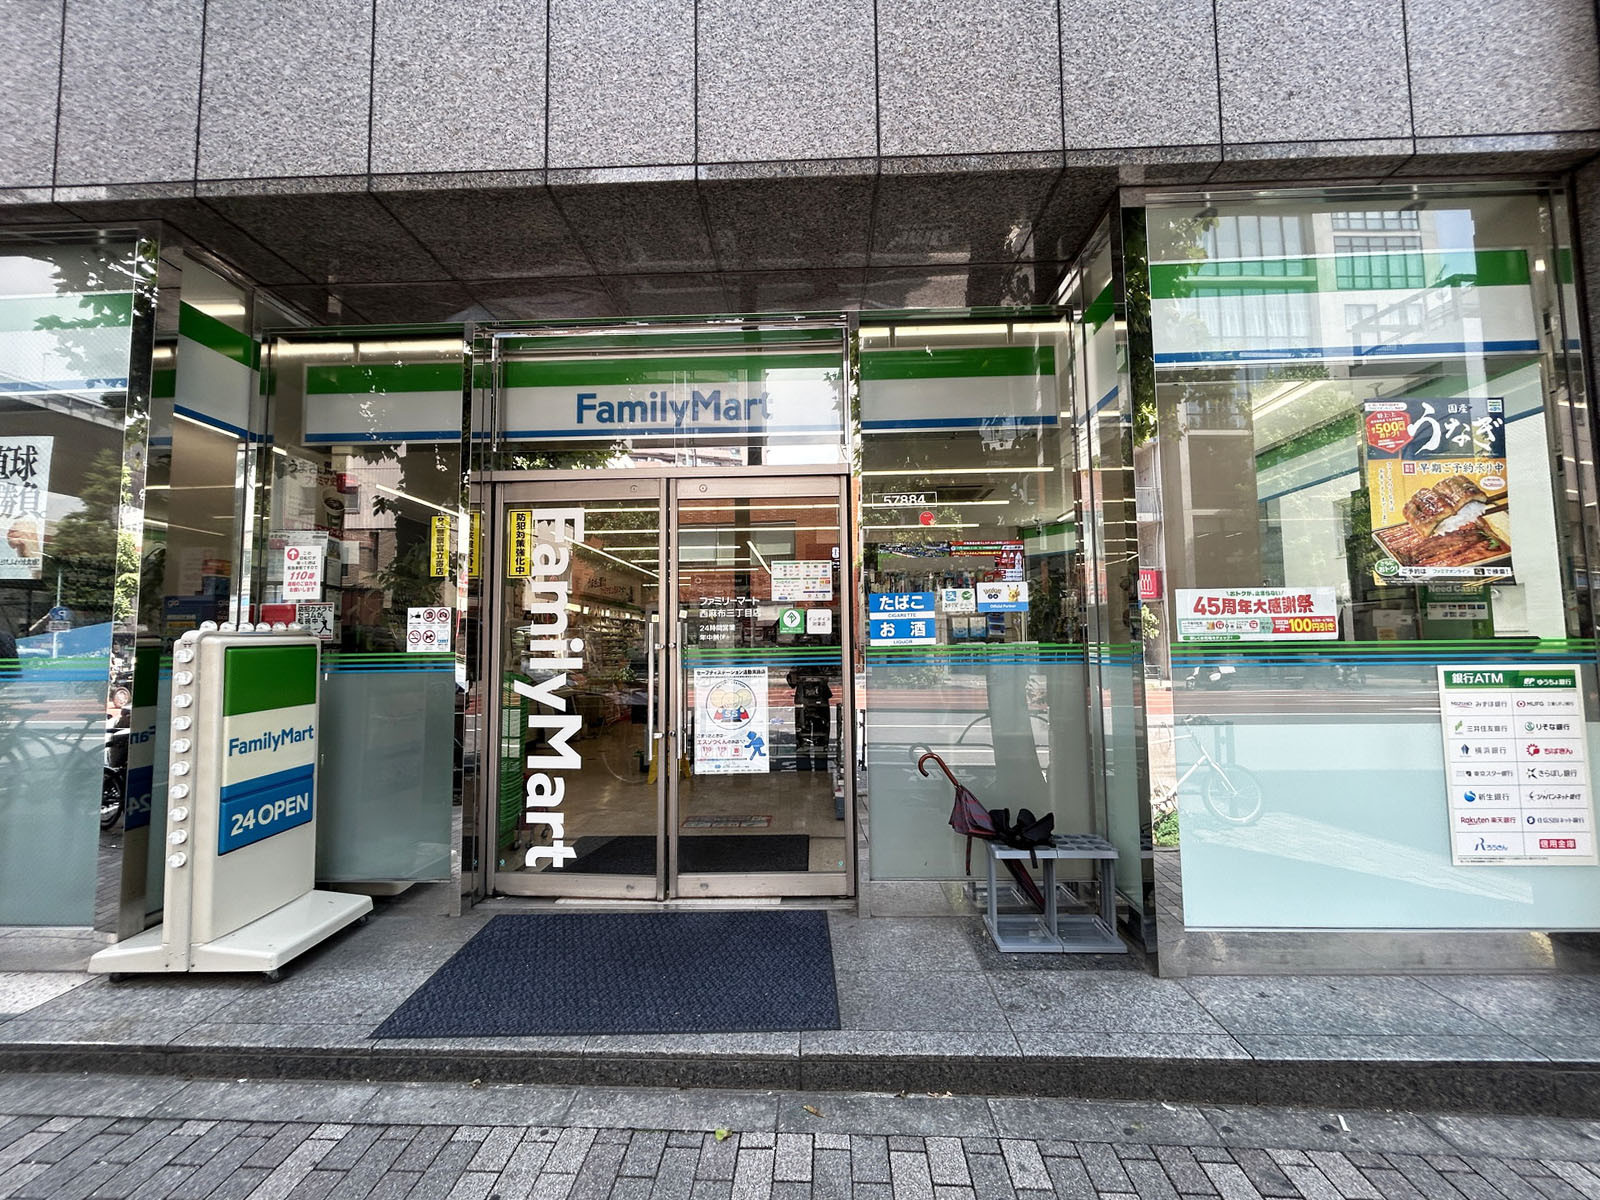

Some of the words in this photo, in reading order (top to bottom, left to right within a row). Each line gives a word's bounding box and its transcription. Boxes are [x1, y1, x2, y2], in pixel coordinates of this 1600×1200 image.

[576, 390, 773, 427] FamilyMart
[1447, 403, 1468, 413] 国産
[1407, 402, 1503, 455] うなぎ
[883, 494, 926, 506] 57884
[515, 513, 526, 574] 防犯対策強化中
[1428, 585, 1450, 593] Need
[699, 596, 760, 606] ファミリーマート
[879, 595, 925, 611] たばこ
[1193, 594, 1315, 616] 45周年大感謝祭
[699, 608, 761, 617] 西麻布三丁目店
[1451, 672, 1504, 684] 銀行ATM
[1536, 678, 1572, 686] ゆうちょ銀行
[514, 508, 584, 867] FamilyMart
[1467, 725, 1508, 733] 三井住友銀行
[1536, 723, 1570, 731] りそな銀行
[229, 724, 314, 757] FamilyMart
[1475, 746, 1507, 755] 横浜銀行
[1538, 769, 1577, 778] きらぼし銀行
[1478, 793, 1510, 801] 新生銀行
[1460, 817, 1489, 825] Rakuten
[1491, 816, 1516, 824] 楽天銀行
[1540, 839, 1576, 849] 信用金庫
